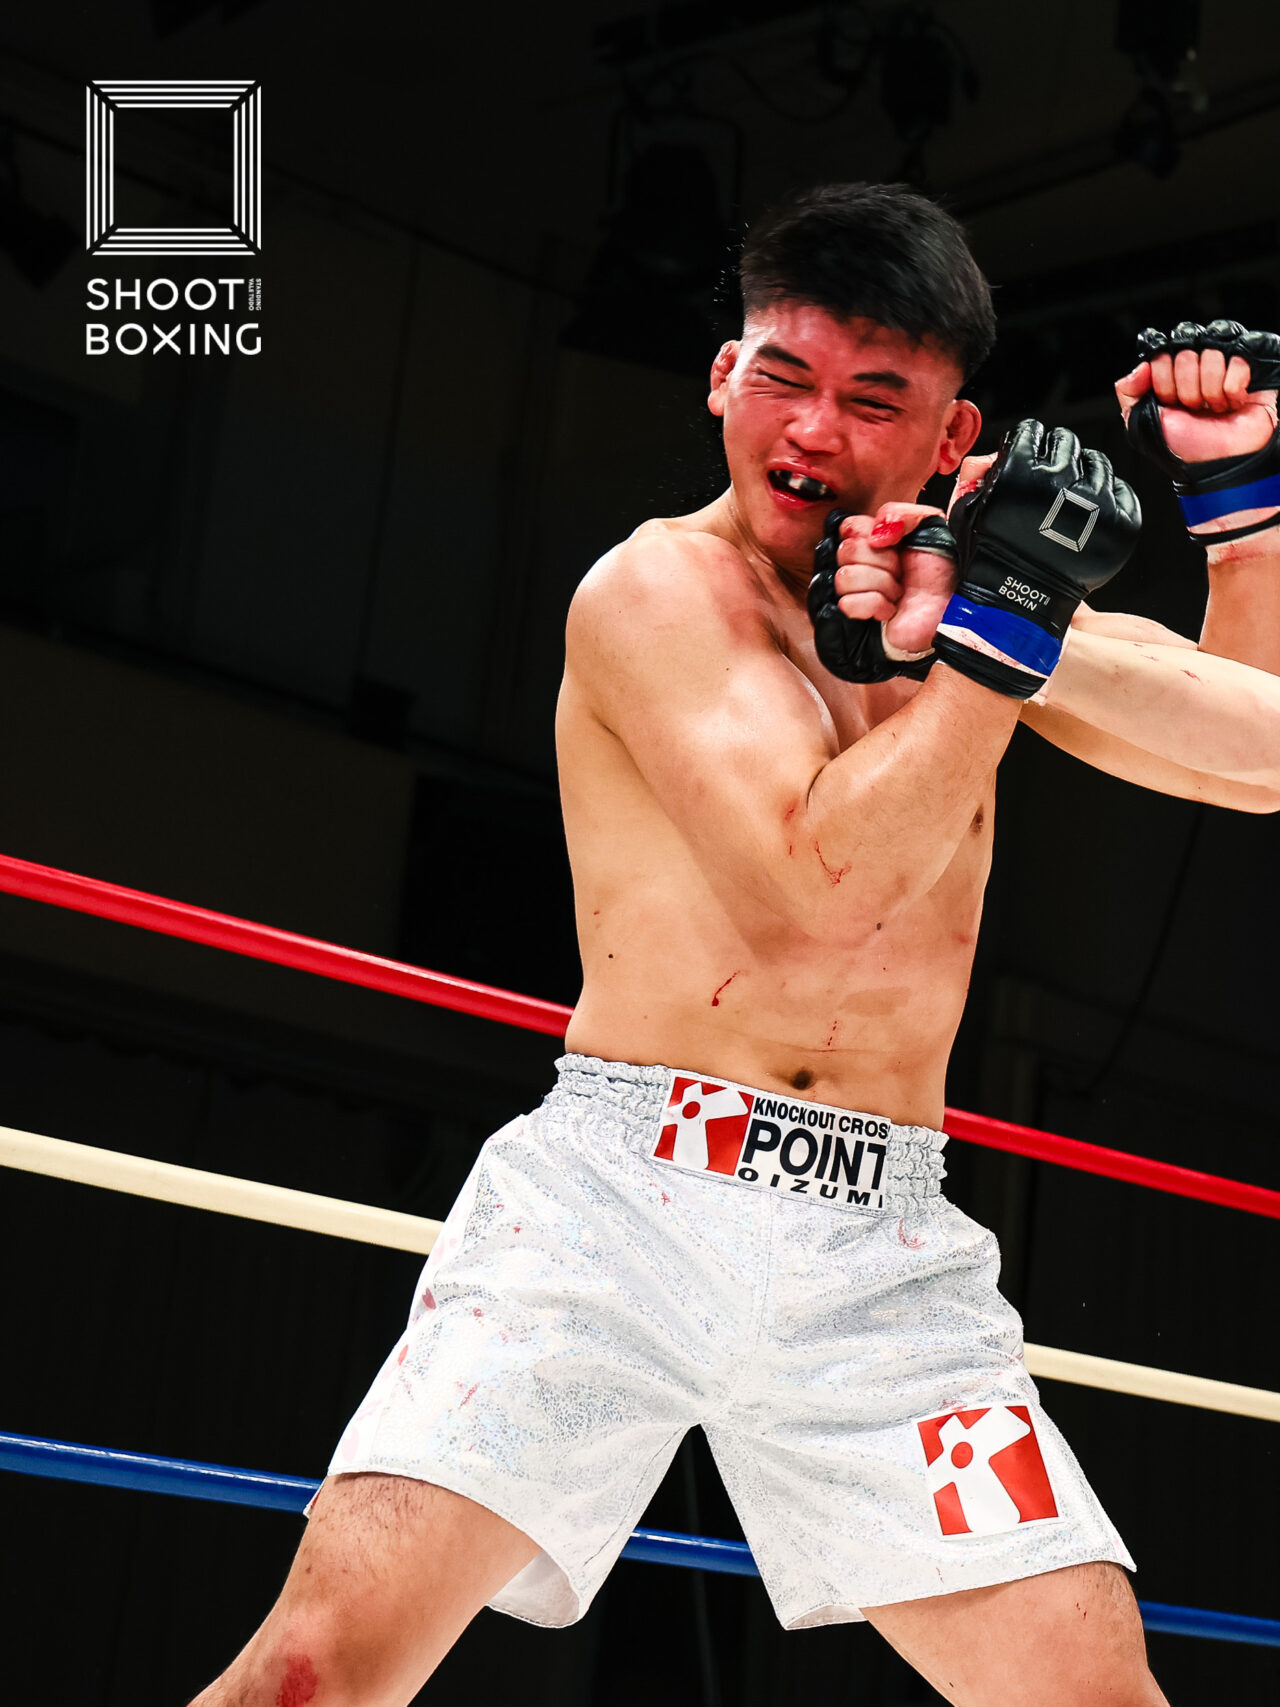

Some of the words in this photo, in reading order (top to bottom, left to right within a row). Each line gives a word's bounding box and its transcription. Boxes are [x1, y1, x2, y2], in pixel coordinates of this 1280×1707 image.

[1004, 576, 1047, 603] SHOOT
[754, 1097, 836, 1131] KNOCKOUT
[838, 1115, 891, 1140] CROS
[742, 1118, 887, 1190] POINT
[737, 1167, 883, 1209] OIZUMI
